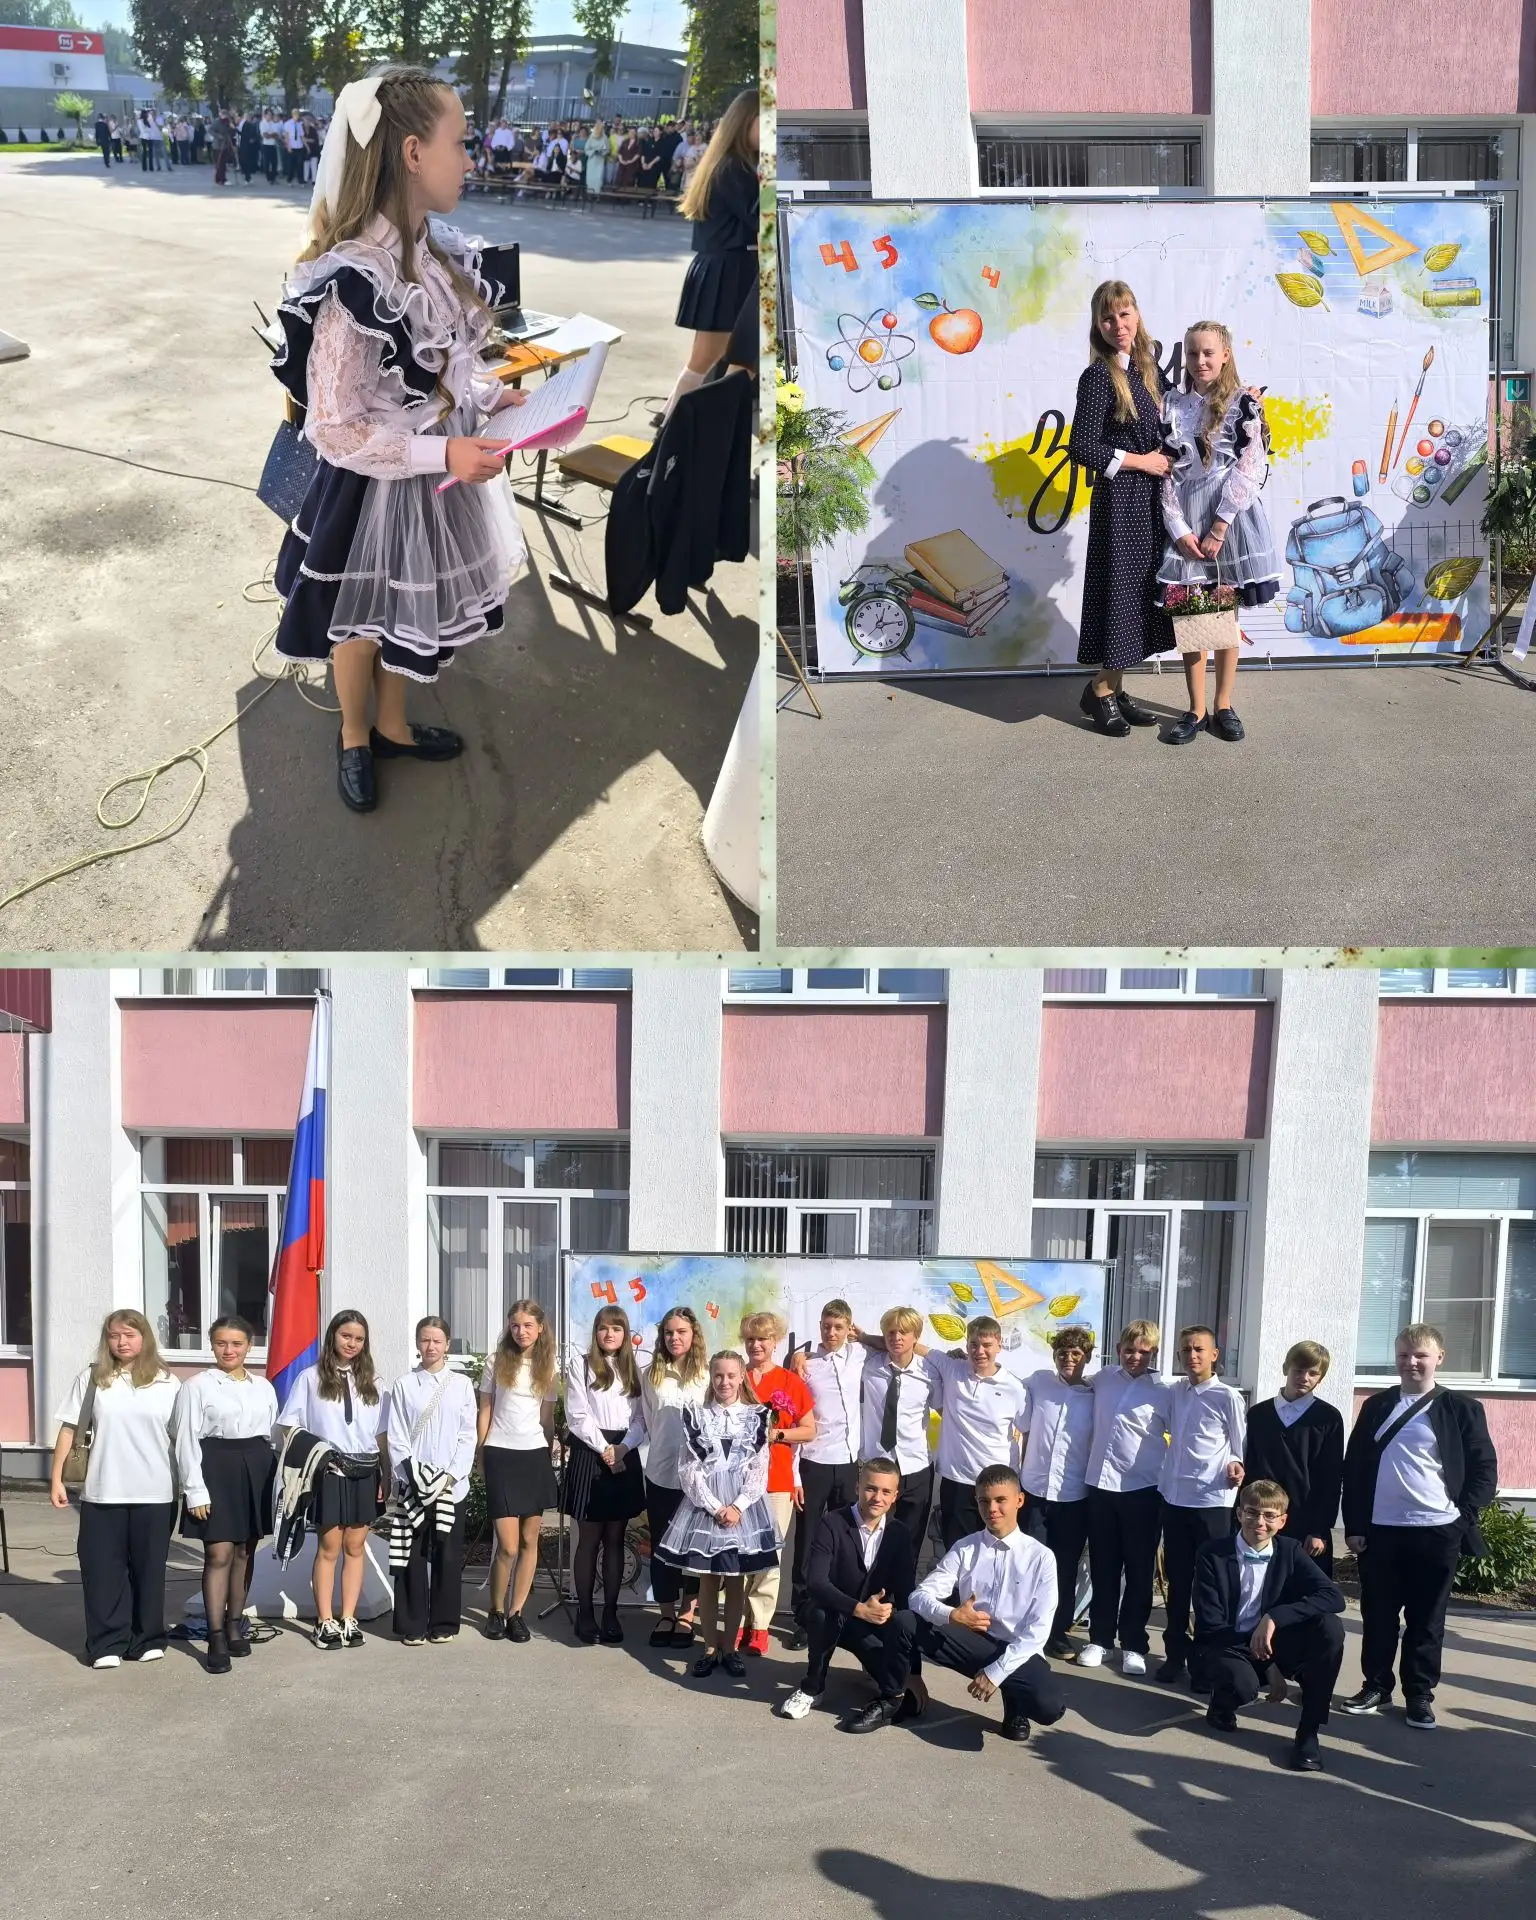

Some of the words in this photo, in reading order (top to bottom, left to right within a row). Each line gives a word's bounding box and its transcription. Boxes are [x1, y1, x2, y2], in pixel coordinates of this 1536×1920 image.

[819, 240, 858, 272] 4
[873, 235, 898, 269] 5
[981, 265, 1000, 288] 4
[1360, 299, 1376, 308] MILK
[591, 1280, 617, 1303] 4
[628, 1277, 646, 1302] 5
[706, 1301, 719, 1318] 4
